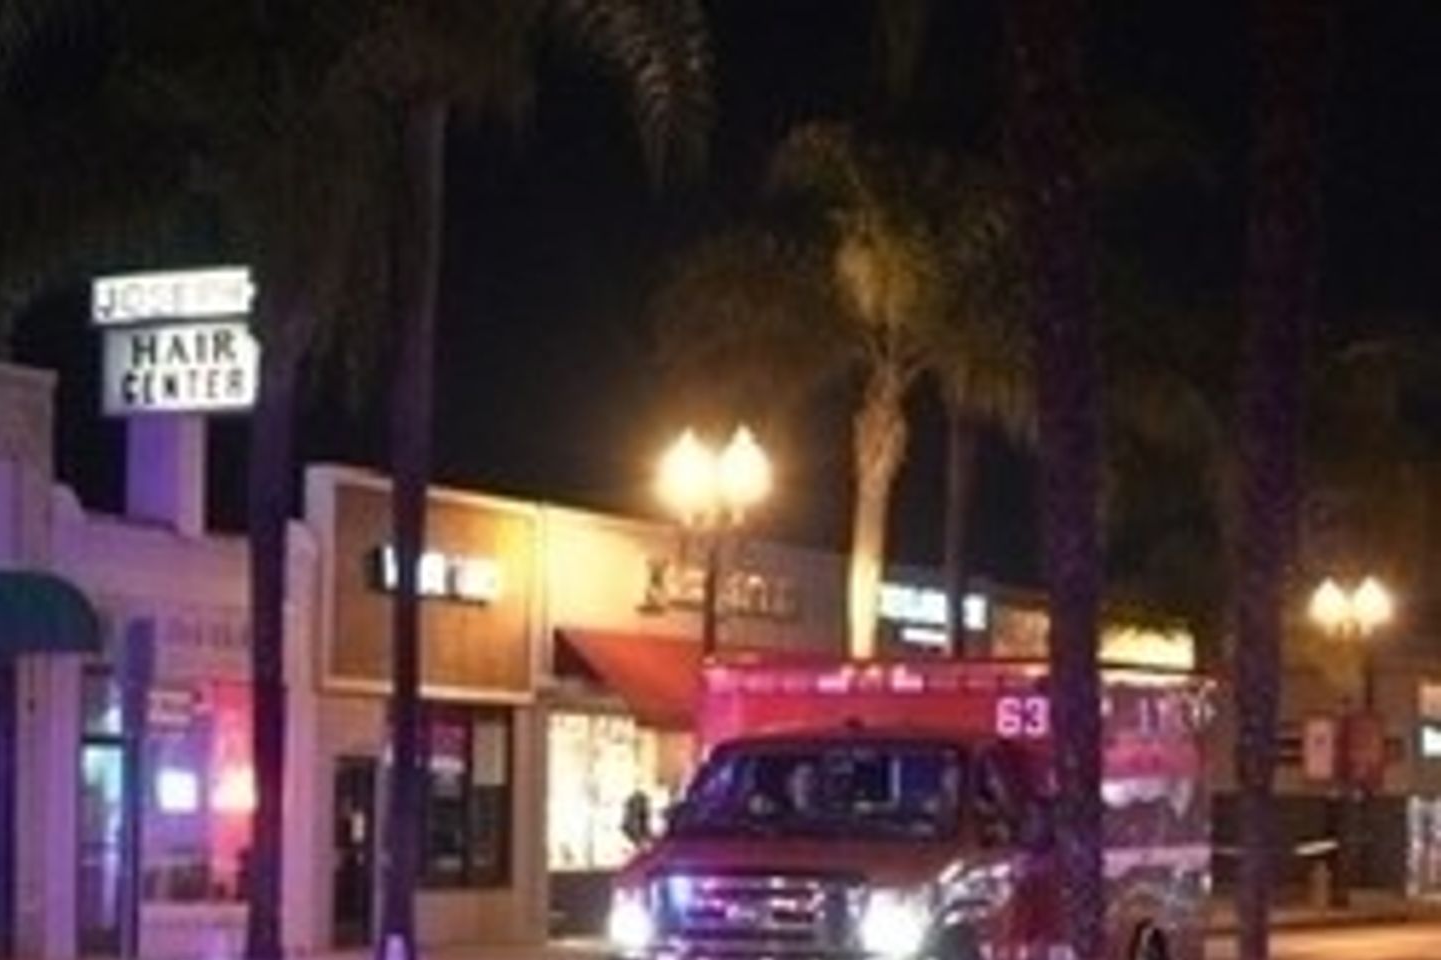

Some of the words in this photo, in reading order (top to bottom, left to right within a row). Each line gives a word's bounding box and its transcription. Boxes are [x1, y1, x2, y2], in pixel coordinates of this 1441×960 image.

[131, 329, 237, 367] HAIR
[121, 368, 246, 404] CENTER
[995, 695, 1050, 738] 63
